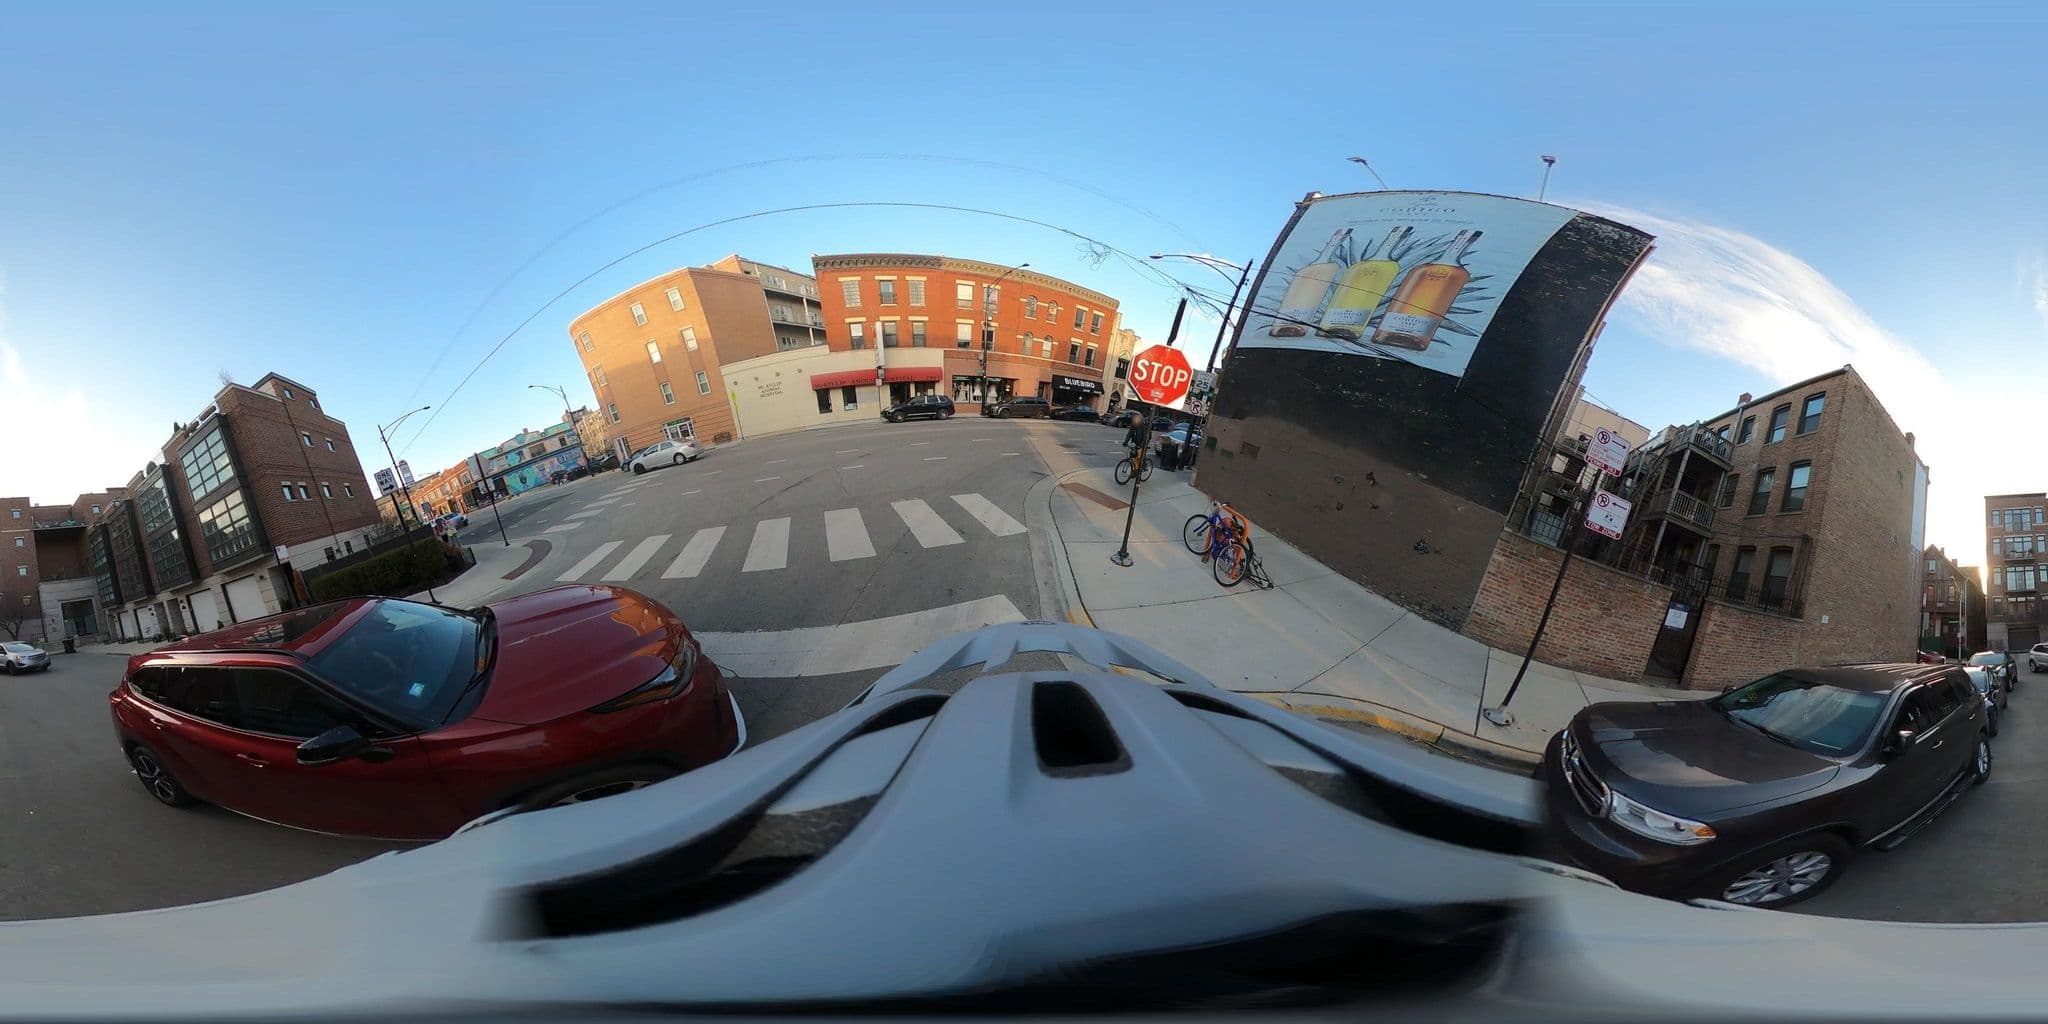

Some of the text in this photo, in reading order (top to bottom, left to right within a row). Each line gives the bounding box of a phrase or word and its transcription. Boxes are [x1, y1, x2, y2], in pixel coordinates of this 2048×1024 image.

[1134, 359, 1188, 390] STOP
[1064, 377, 1096, 388] BLUEBIRD
[1196, 380, 1209, 389] 25
[377, 470, 391, 481] ONE
[380, 476, 394, 486] WAY
